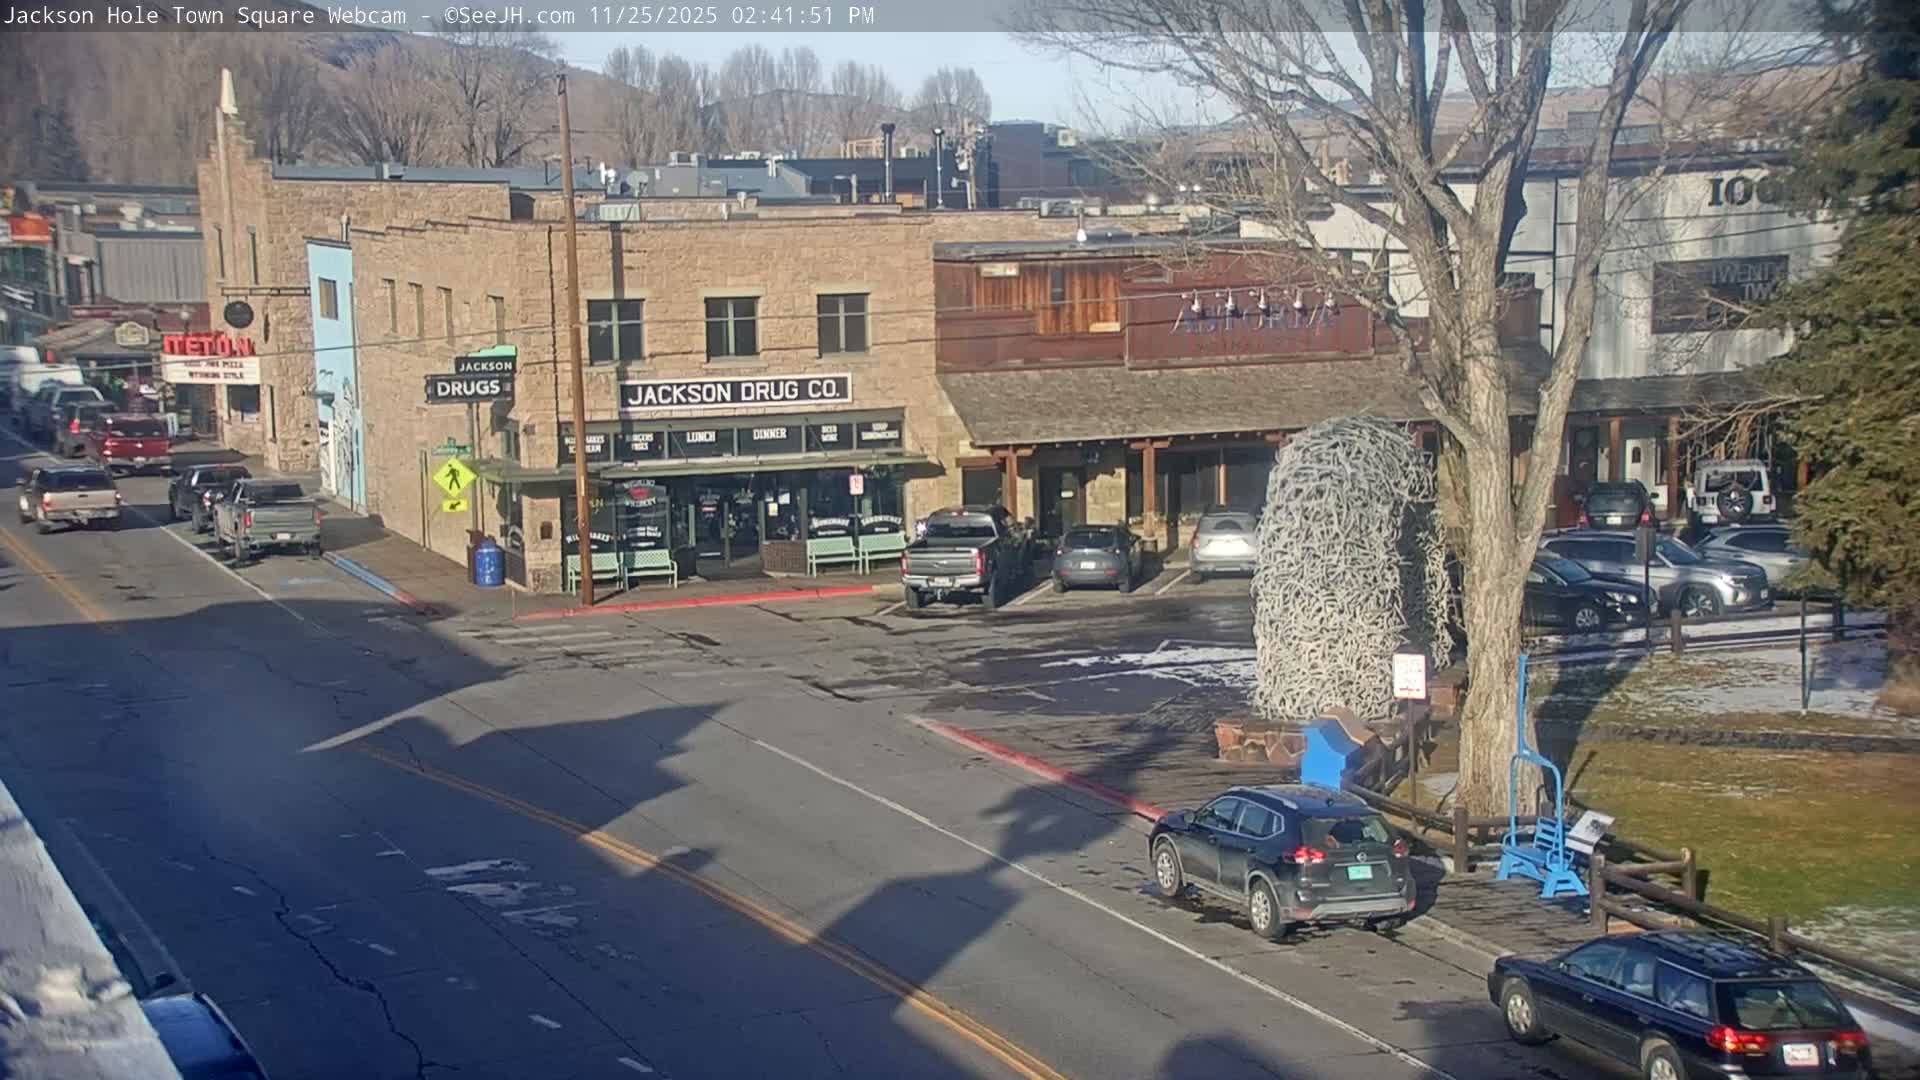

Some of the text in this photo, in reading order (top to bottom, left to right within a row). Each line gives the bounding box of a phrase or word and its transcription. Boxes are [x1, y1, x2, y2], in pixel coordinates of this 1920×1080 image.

[163, 335, 252, 356] TETON
[459, 361, 513, 372] JACKSON
[436, 380, 501, 397] DRUGS
[628, 379, 840, 405] JACKSON DRUG CO.
[686, 431, 716, 443] LUNCH
[752, 427, 787, 440] DINNER
